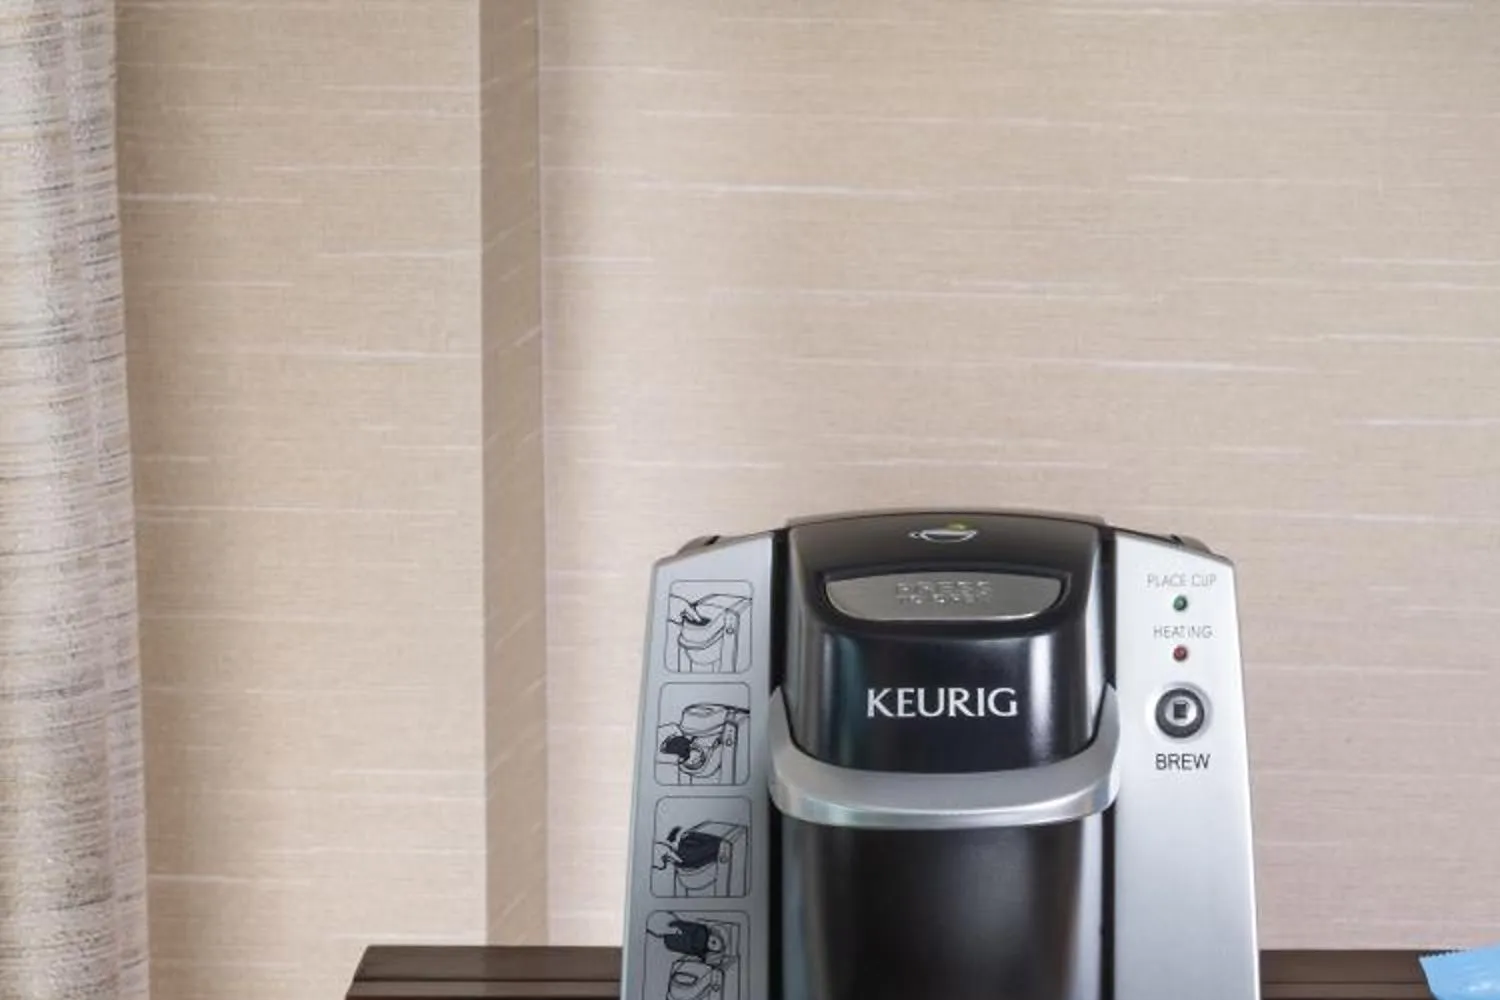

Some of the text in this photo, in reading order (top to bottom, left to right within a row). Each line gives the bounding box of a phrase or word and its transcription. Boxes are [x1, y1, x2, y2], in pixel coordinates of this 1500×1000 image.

[1146, 574, 1217, 587] PLACE CUP
[1153, 625, 1214, 638] HEATING
[866, 686, 1019, 718] KEURIG
[1154, 753, 1212, 770] BREW
